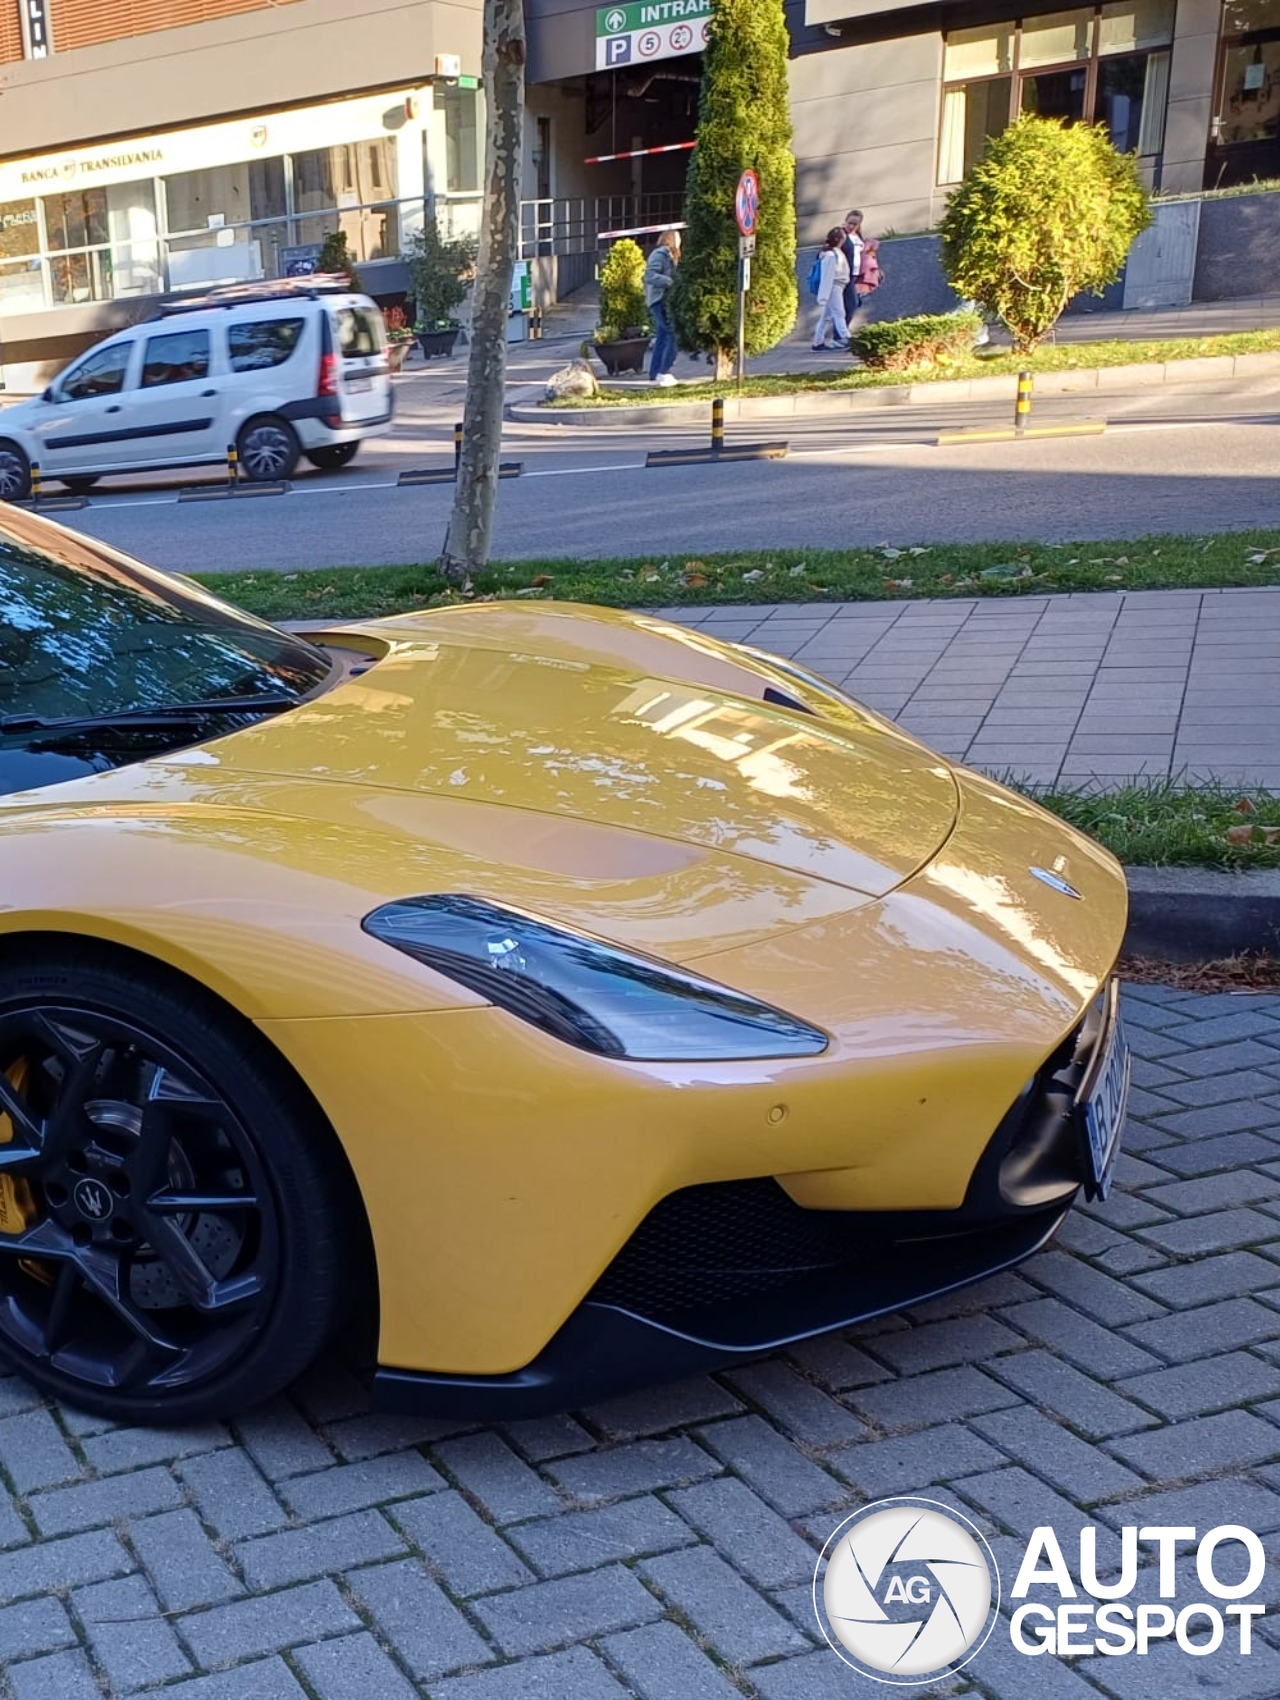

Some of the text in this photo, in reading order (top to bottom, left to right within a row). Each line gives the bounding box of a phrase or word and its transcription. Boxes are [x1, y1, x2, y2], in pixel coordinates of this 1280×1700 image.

[611, 40, 627, 62] P
[645, 37, 655, 51] 5
[21, 168, 58, 184] BANCA
[79, 149, 164, 173] TRANSILVANIA
[1095, 1093, 1108, 1157] B
